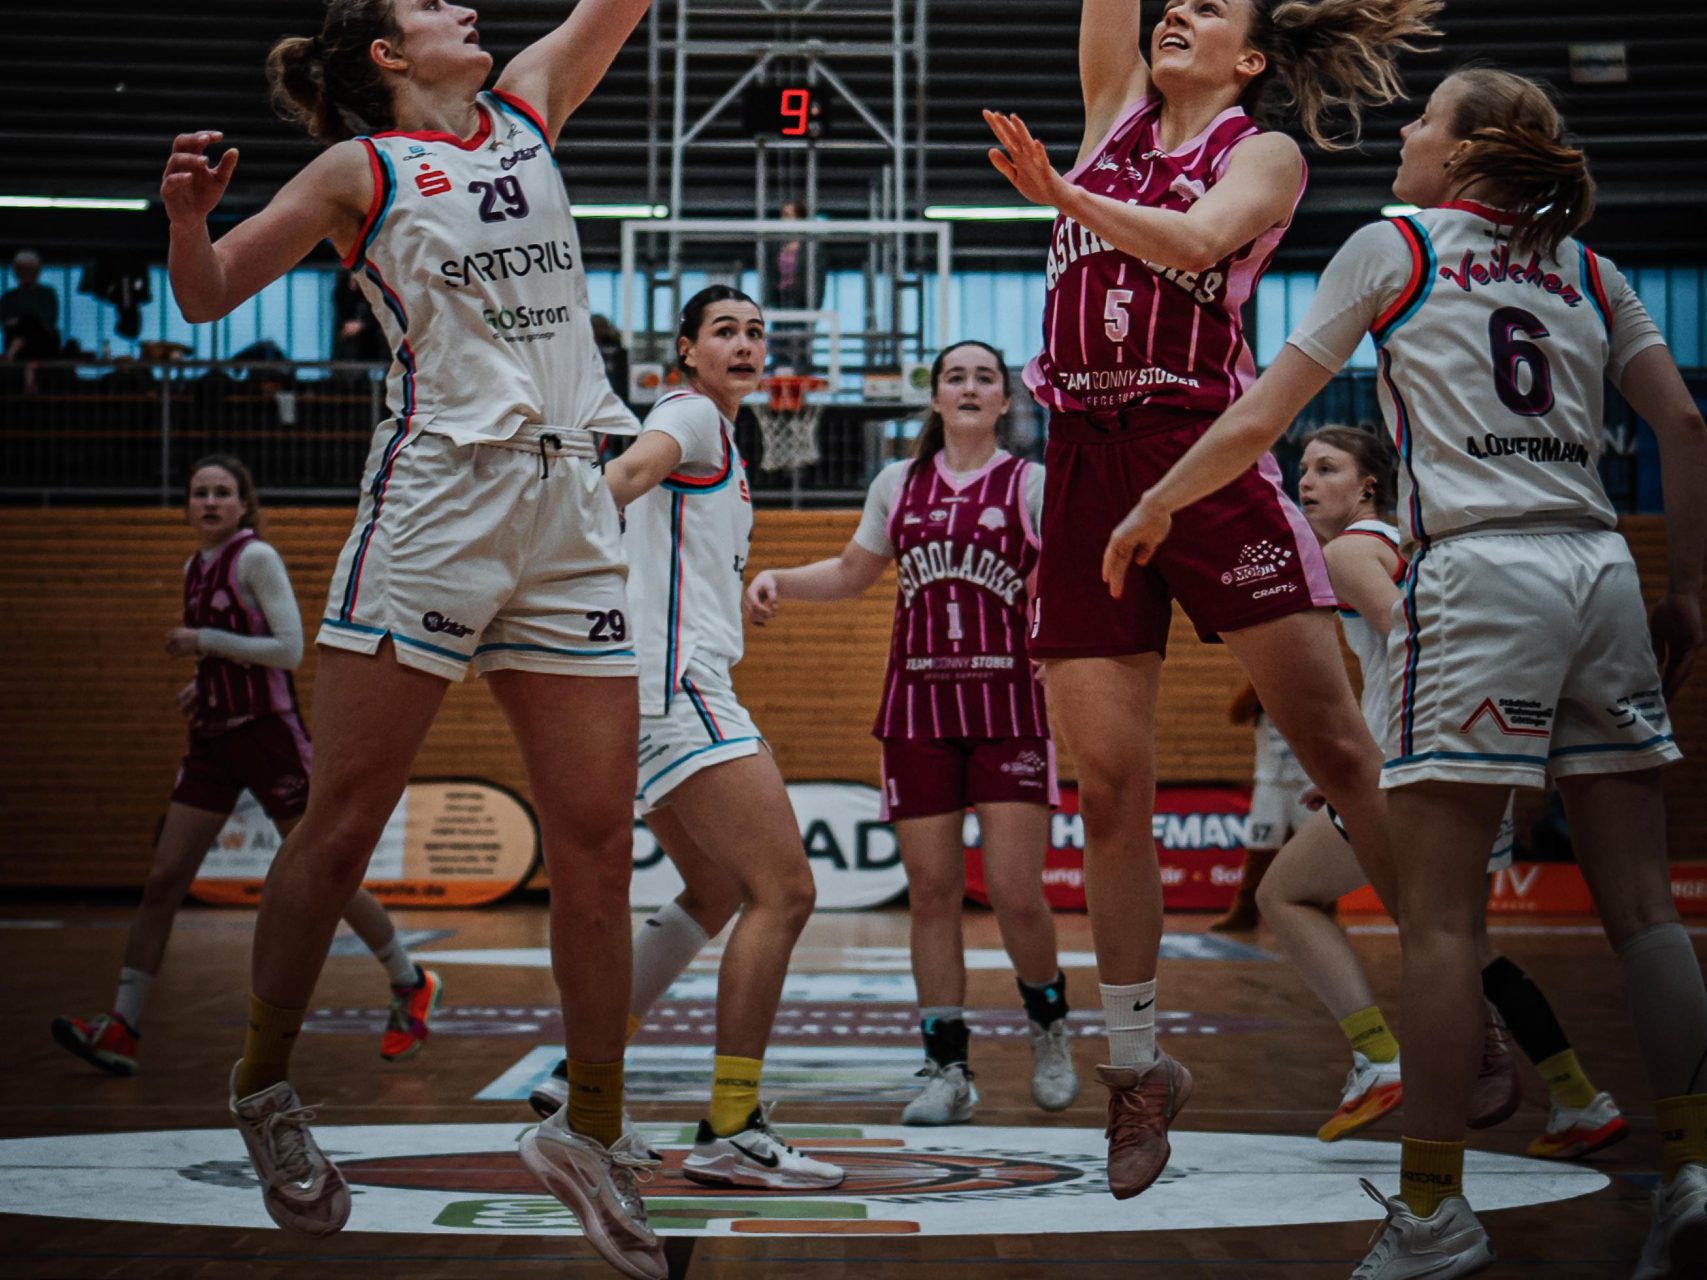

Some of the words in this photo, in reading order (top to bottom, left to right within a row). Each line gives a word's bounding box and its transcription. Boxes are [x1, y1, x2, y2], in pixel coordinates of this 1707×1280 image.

[781, 88, 811, 136] 9
[468, 175, 529, 223] 29
[1104, 289, 1133, 342] 5
[1489, 306, 1554, 417] 6
[899, 540, 1024, 609] STROLADIES
[586, 610, 626, 641] 29
[946, 602, 963, 640] 1
